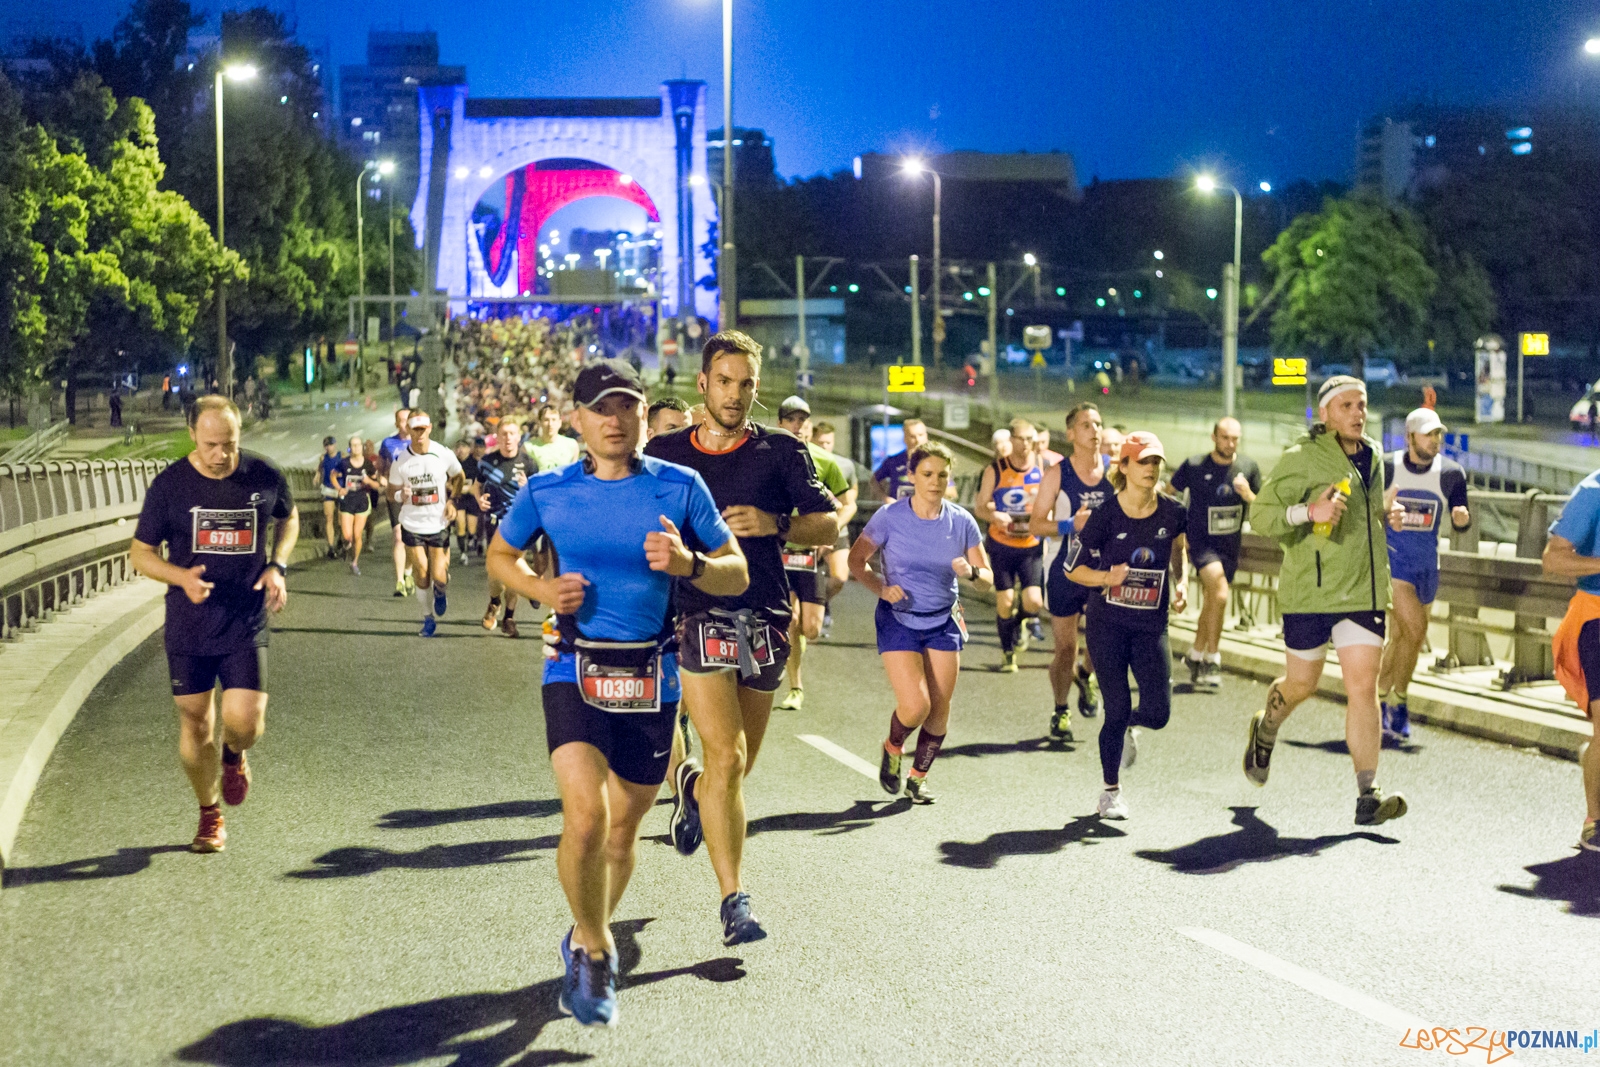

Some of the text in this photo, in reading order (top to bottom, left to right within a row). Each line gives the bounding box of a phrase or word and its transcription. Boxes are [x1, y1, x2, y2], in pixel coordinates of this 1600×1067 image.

[210, 531, 240, 545] 6791
[1120, 586, 1151, 600] 10717
[719, 641, 738, 657] 87
[595, 679, 645, 698] 10390
